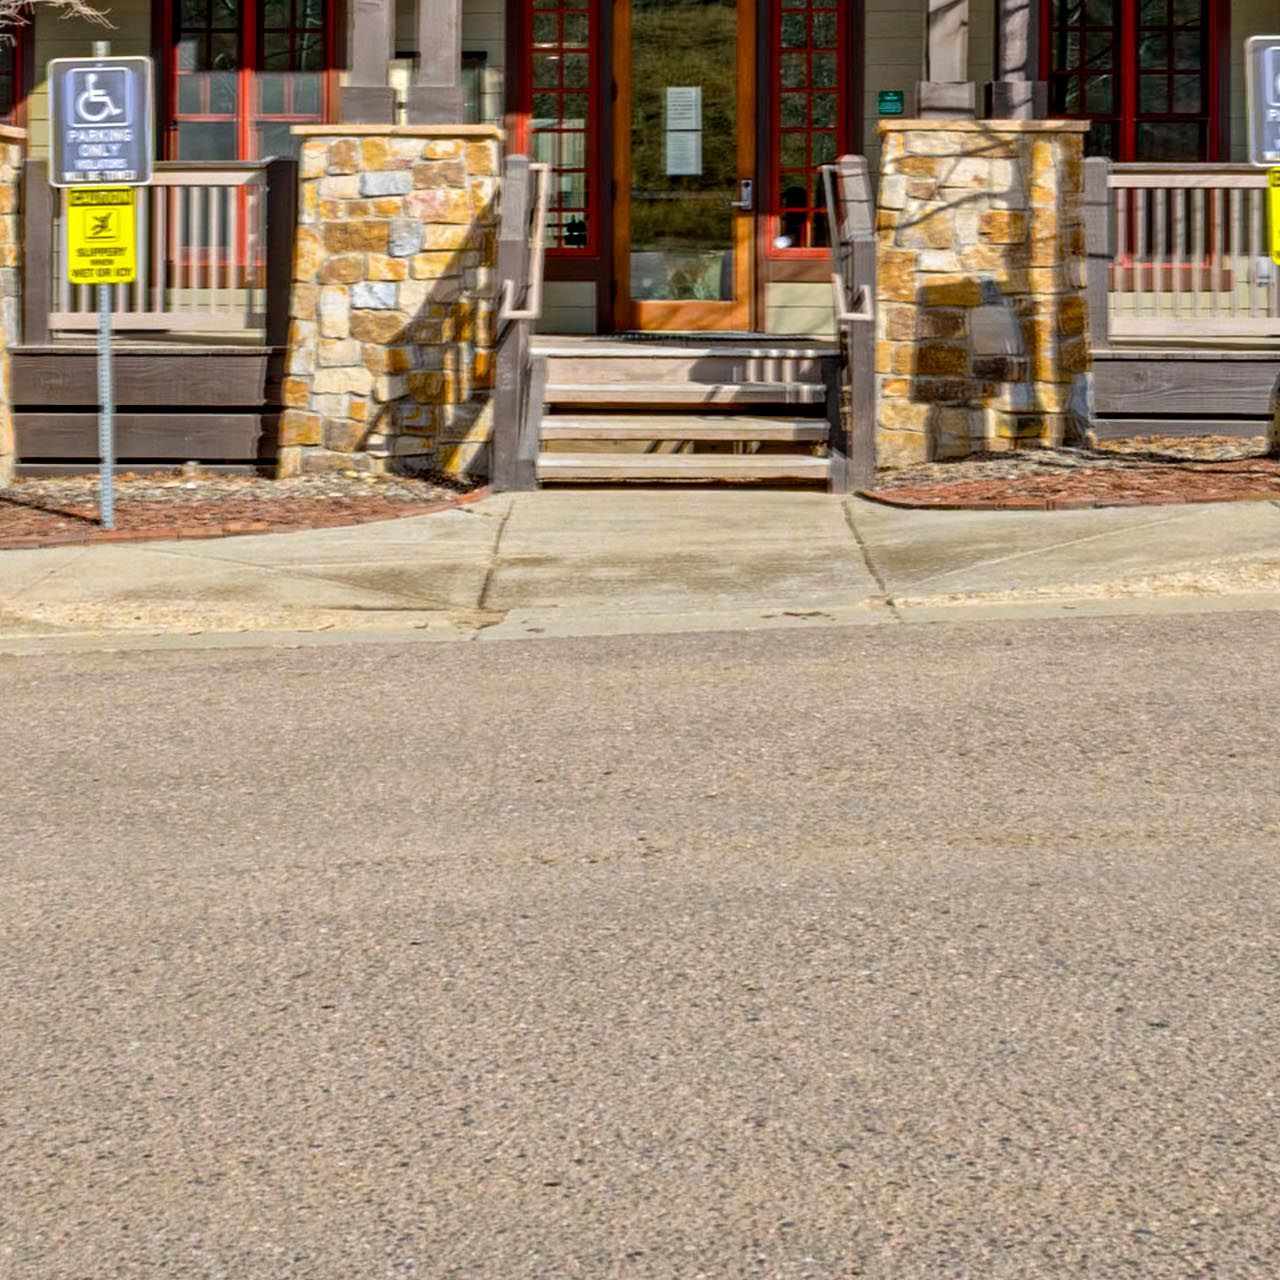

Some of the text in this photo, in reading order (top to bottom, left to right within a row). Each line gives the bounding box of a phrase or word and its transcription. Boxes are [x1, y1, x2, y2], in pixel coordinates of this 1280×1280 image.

[66, 128, 133, 143] PARKING
[77, 143, 122, 157] ONLY
[76, 247, 128, 257] SLIPPERY
